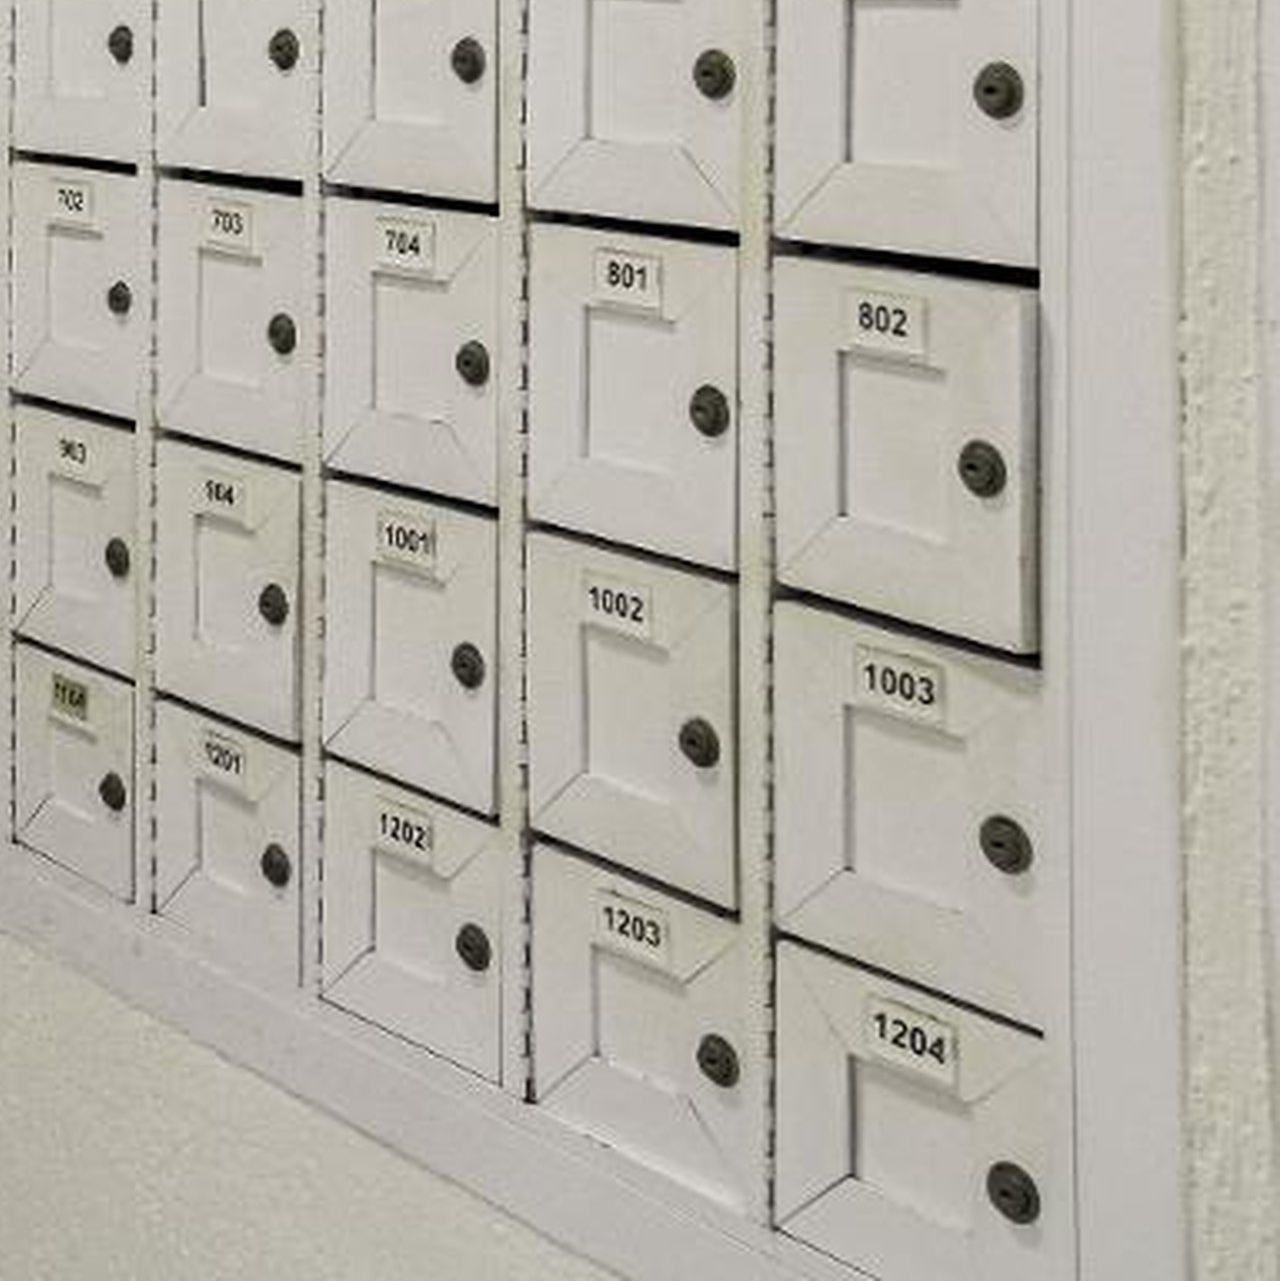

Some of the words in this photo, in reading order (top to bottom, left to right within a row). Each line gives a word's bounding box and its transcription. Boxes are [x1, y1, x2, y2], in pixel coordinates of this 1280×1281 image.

[212, 210, 243, 235] 703
[385, 230, 420, 256] 704
[606, 260, 648, 289] 801
[857, 302, 908, 337] 802
[385, 524, 430, 553] 1001
[588, 586, 644, 623] 1002
[863, 663, 935, 705] 1003
[205, 742, 242, 774] 1201
[380, 813, 426, 849] 1202
[603, 906, 662, 948] 1203
[873, 1012, 946, 1064] 1204
